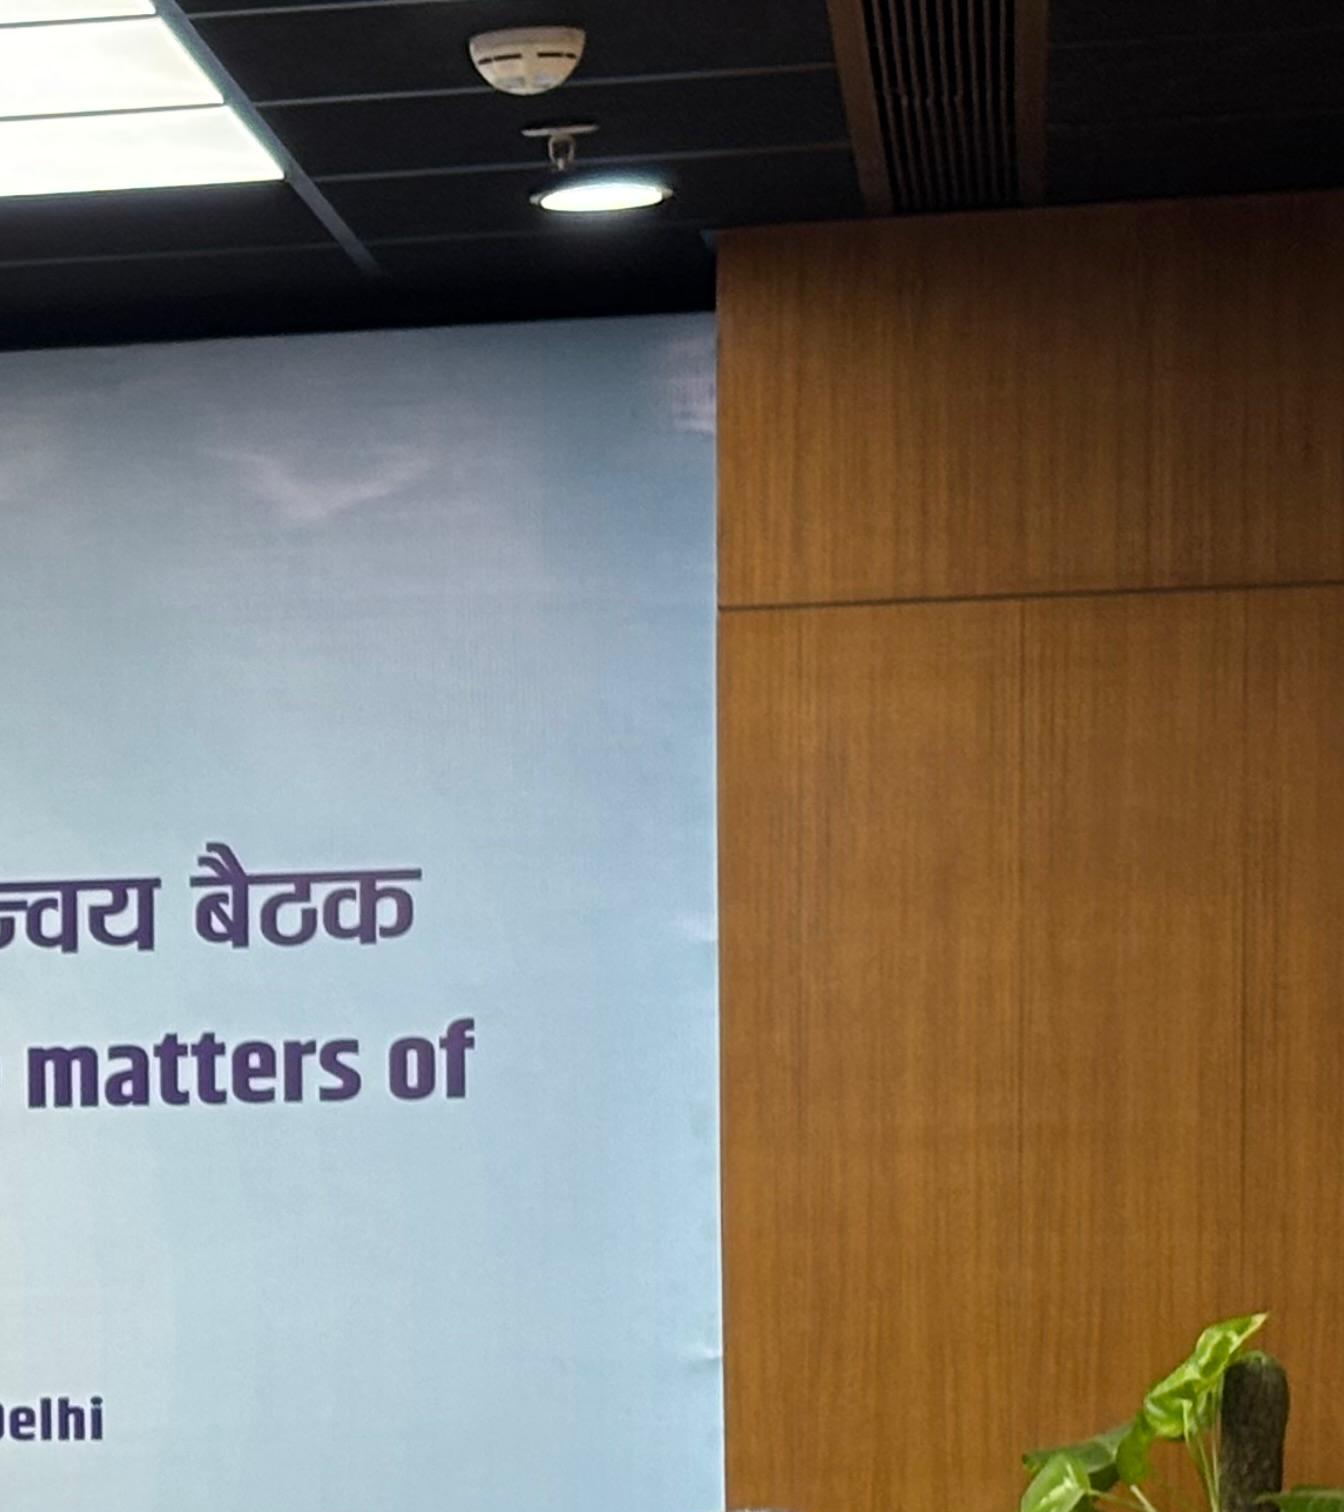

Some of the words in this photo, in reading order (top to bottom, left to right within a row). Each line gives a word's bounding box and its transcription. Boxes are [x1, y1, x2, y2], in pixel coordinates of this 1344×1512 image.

[190, 843, 422, 948] बैठक
[28, 1033, 361, 1108] matters
[390, 1018, 474, 1100] of
